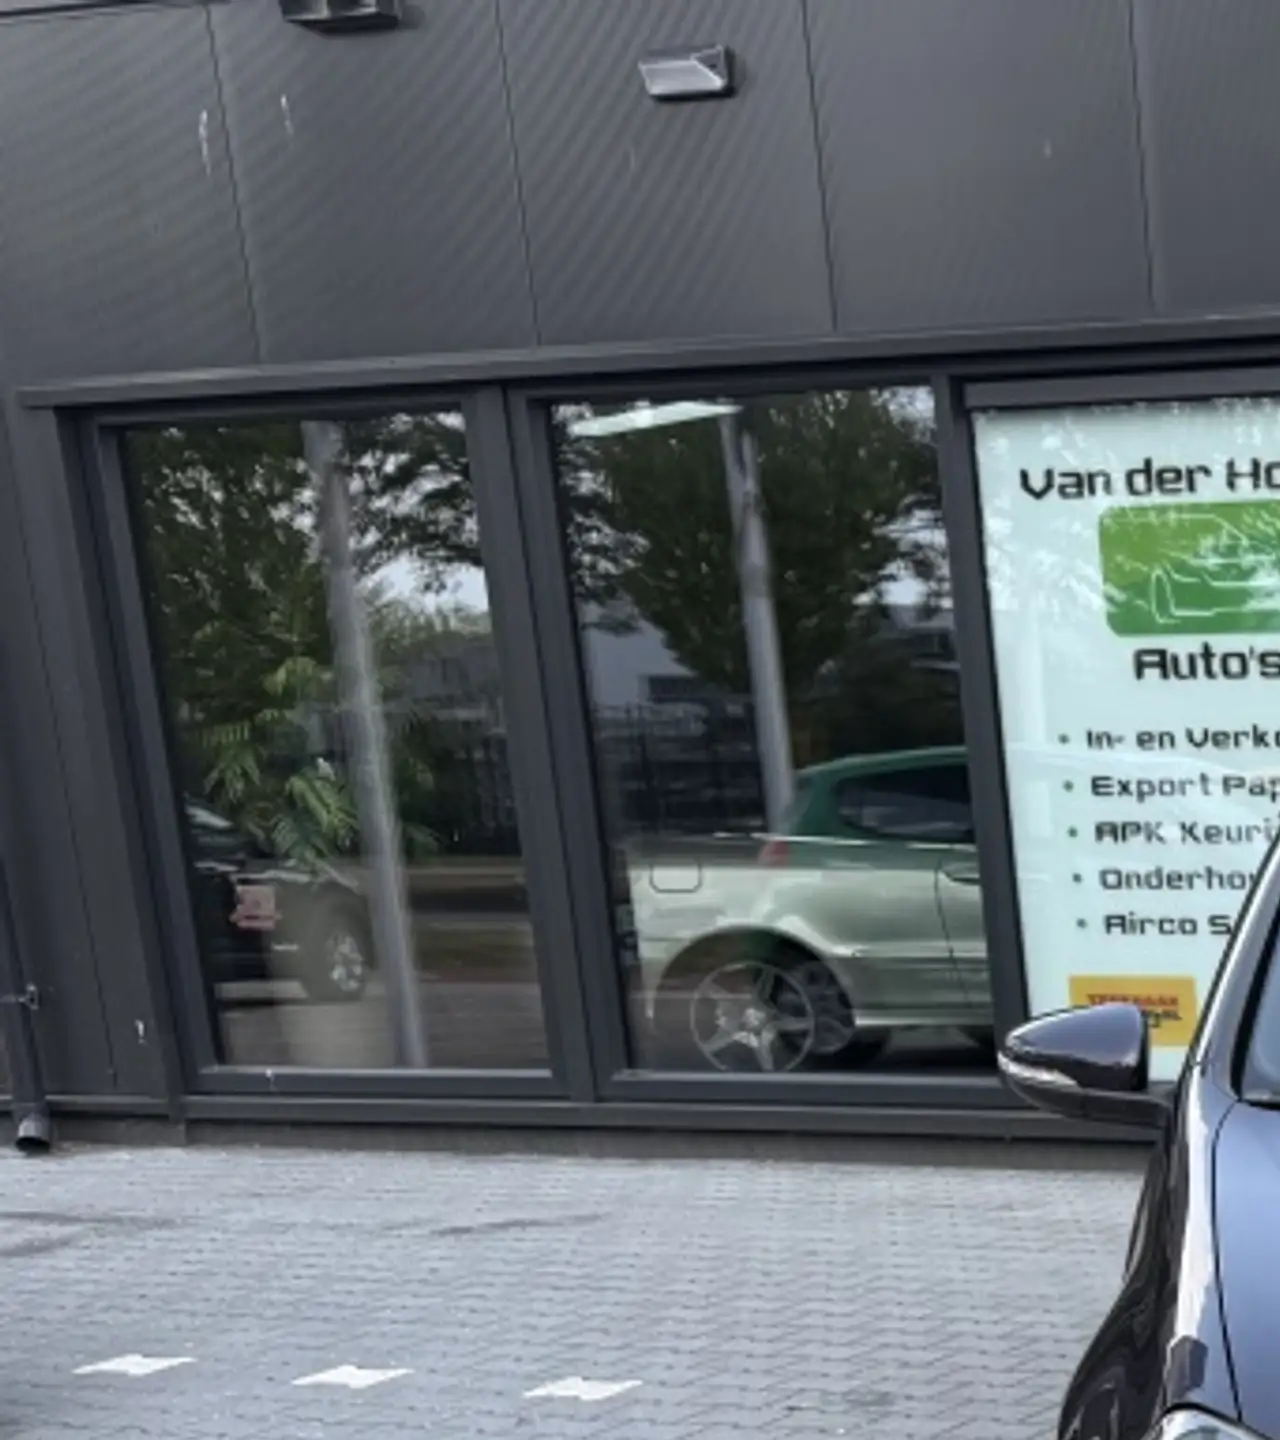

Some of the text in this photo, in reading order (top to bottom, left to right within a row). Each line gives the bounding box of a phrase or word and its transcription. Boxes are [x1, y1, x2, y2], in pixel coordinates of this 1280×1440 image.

[1020, 467, 1111, 499] Van
[1125, 458, 1212, 496] der
[1086, 727, 1126, 750] In-
[1135, 729, 1176, 750] en
[1090, 772, 1211, 804] Export
[1095, 817, 1277, 845] APK Keuri
[1104, 911, 1198, 936] Airco
